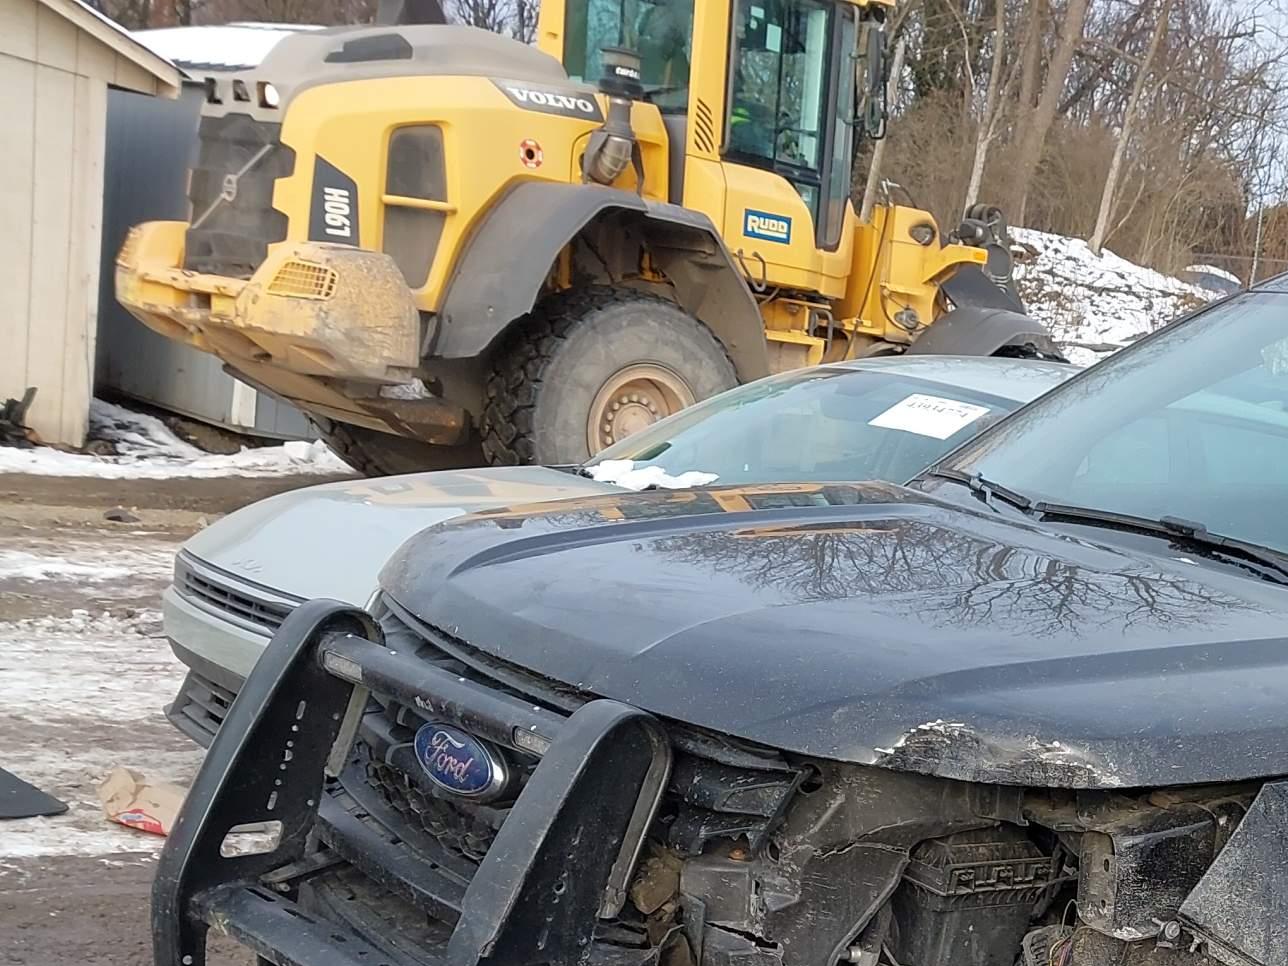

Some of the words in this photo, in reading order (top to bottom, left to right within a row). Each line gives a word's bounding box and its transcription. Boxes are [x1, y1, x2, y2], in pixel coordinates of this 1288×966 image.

[506, 87, 595, 113] VOLVO
[323, 187, 351, 237] L90H
[747, 214, 789, 239] RUDD
[425, 730, 474, 783] Ford
